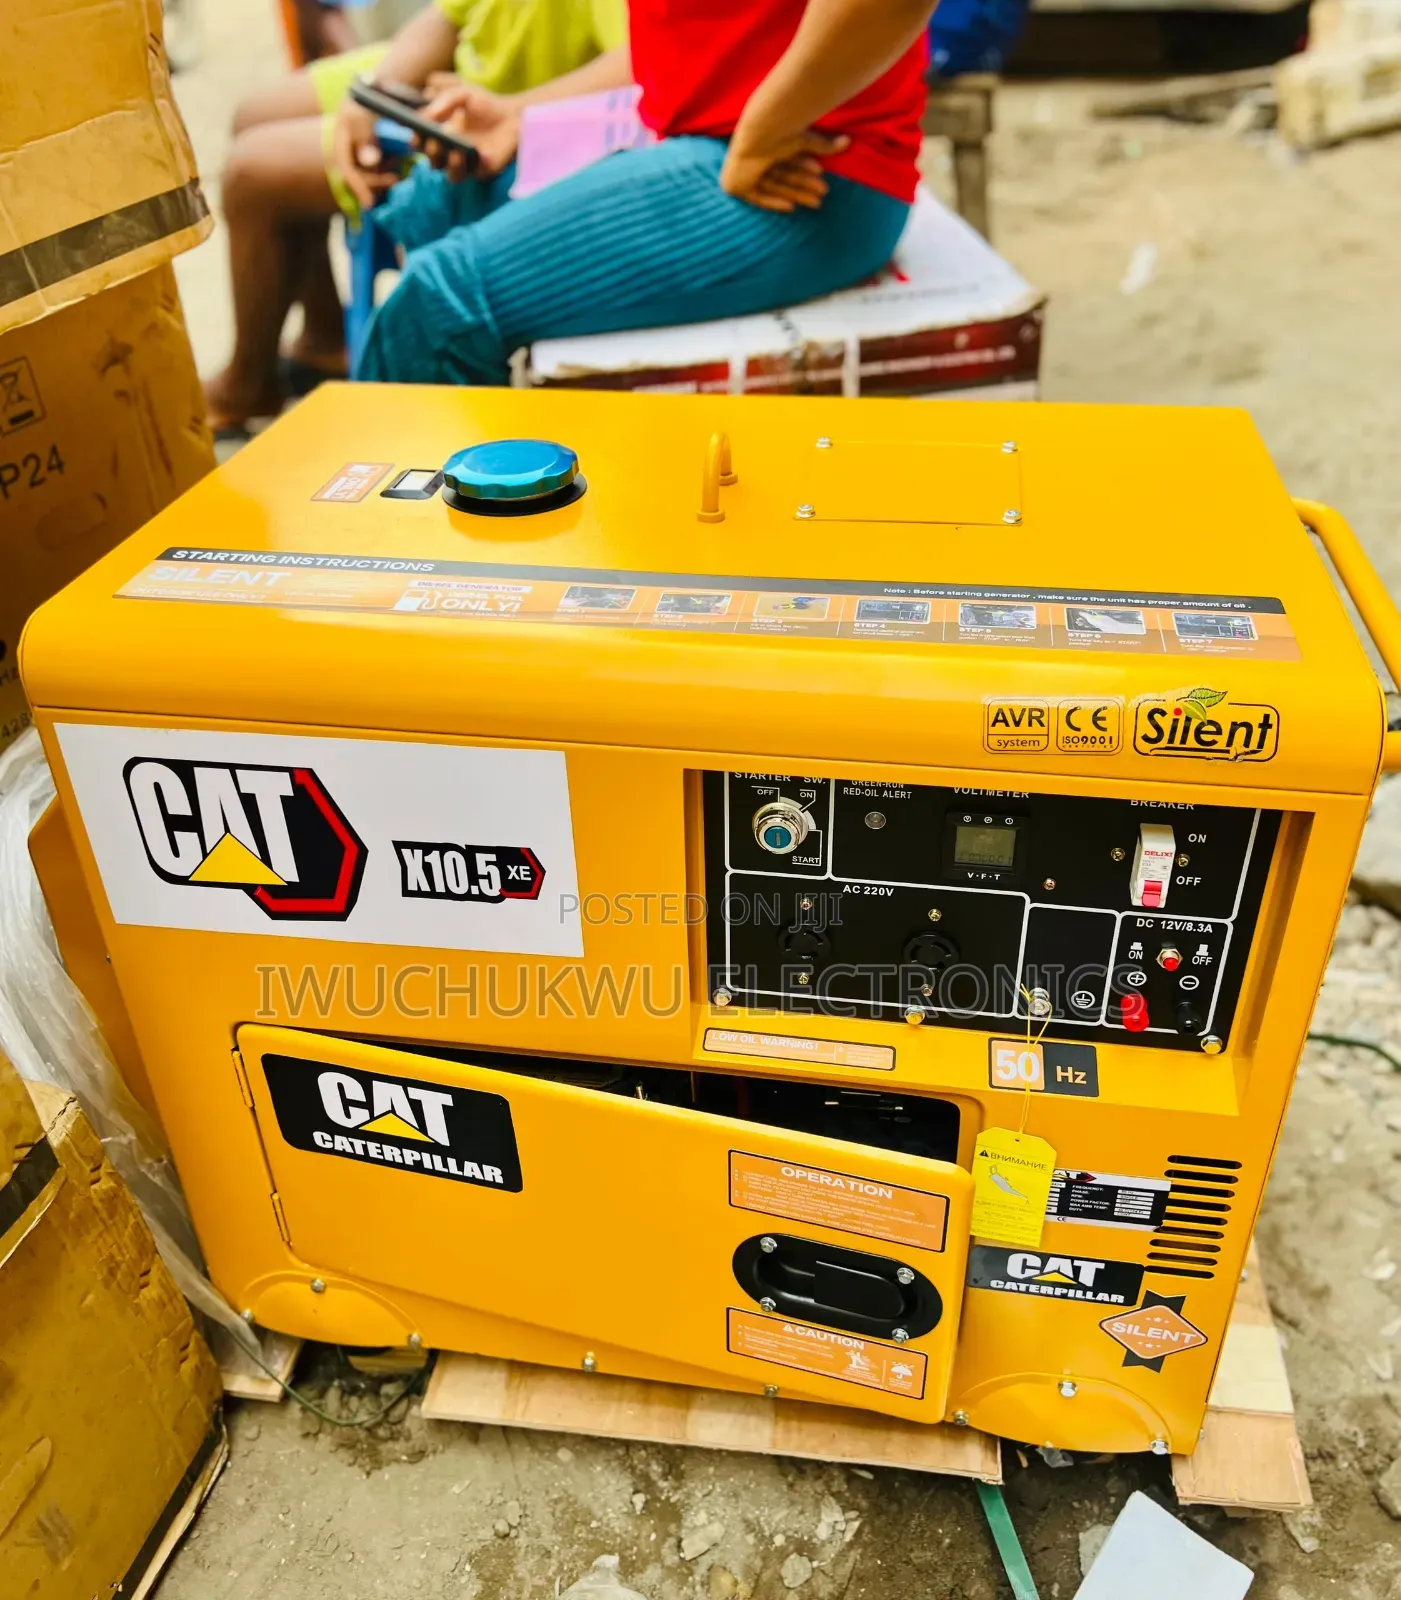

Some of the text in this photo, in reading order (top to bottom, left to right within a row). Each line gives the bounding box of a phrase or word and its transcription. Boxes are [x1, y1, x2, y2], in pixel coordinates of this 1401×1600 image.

[172, 550, 436, 572] STARTING INSTRUCTIONS
[148, 566, 292, 587] SILENT
[947, 590, 982, 598] starting
[440, 598, 522, 612] ONLY!
[991, 707, 1045, 728] AVR
[1141, 706, 1273, 750] Silent
[997, 737, 1040, 749] system
[1062, 735, 1113, 745] ISO9001
[734, 772, 826, 784] STARTER SW.
[843, 787, 912, 800] RED-OIL ALERT
[954, 787, 1030, 799] VOLTMETER
[1130, 799, 1195, 810] BREAKER
[129, 760, 300, 883] CAT
[1188, 833, 1207, 843] ON
[792, 855, 820, 864] START
[401, 847, 532, 896] X10.5 XE
[1176, 875, 1201, 886] OFF
[843, 884, 894, 897] AC 220V
[1136, 918, 1213, 933] DC 12V/8.3A
[1128, 951, 1212, 966] ON OFF
[712, 1034, 738, 1043] LOW
[740, 1035, 757, 1044] OIL
[760, 1037, 819, 1051] WARNING!
[996, 1050, 1087, 1085] 50 Hz
[317, 1072, 454, 1147] CAT
[312, 1131, 504, 1184] CATERPILLAR
[990, 1152, 1047, 1170] ВНИМАНИЕ
[781, 1166, 893, 1199] OPERATION
[1054, 1169, 1082, 1180] AT
[1006, 1253, 1105, 1287] CAT
[990, 1279, 1125, 1304] CATERPILLAR
[795, 1325, 865, 1350] CAUTION
[1111, 1321, 1197, 1344] SILENT
